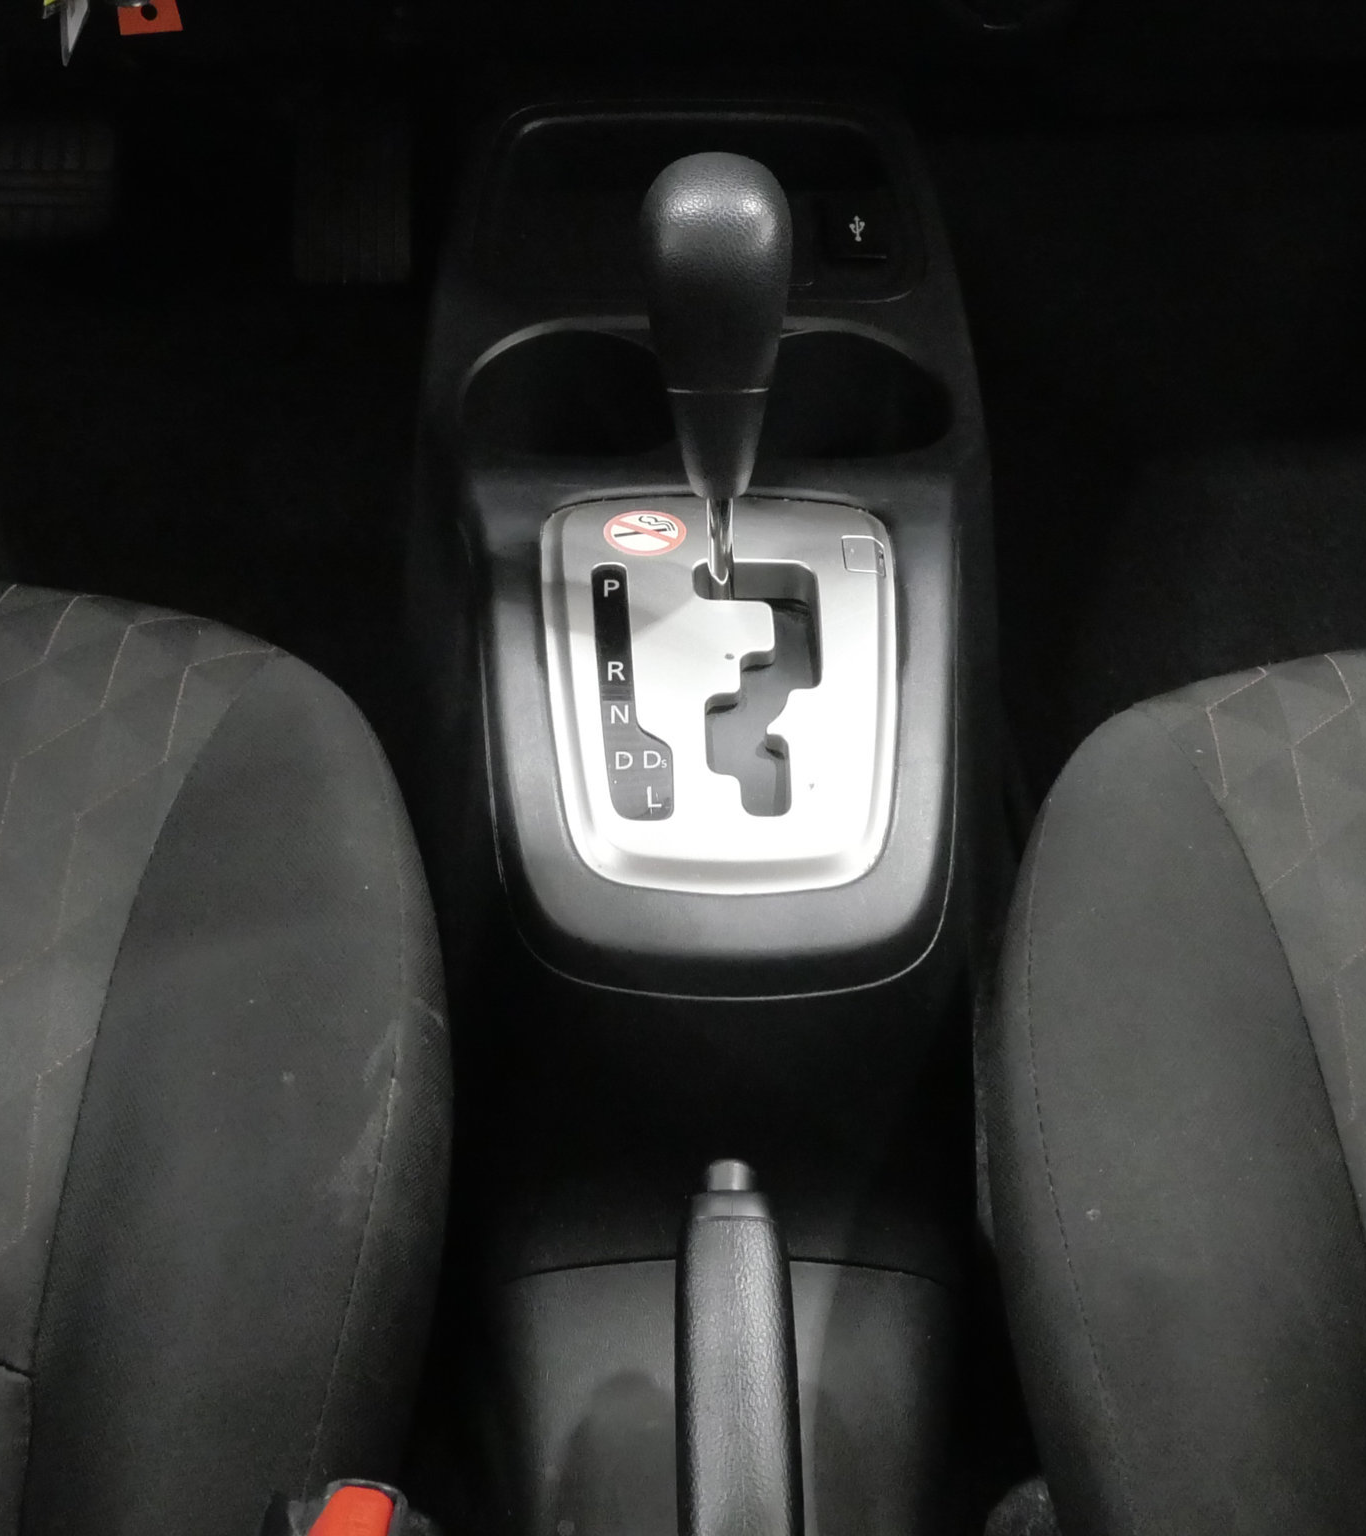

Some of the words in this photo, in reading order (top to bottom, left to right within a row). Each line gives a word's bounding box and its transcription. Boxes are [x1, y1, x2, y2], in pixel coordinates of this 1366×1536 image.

[603, 579, 620, 598] P
[607, 661, 626, 682] R
[610, 704, 630, 724] N
[614, 751, 634, 770] D
[646, 785, 663, 809] L
